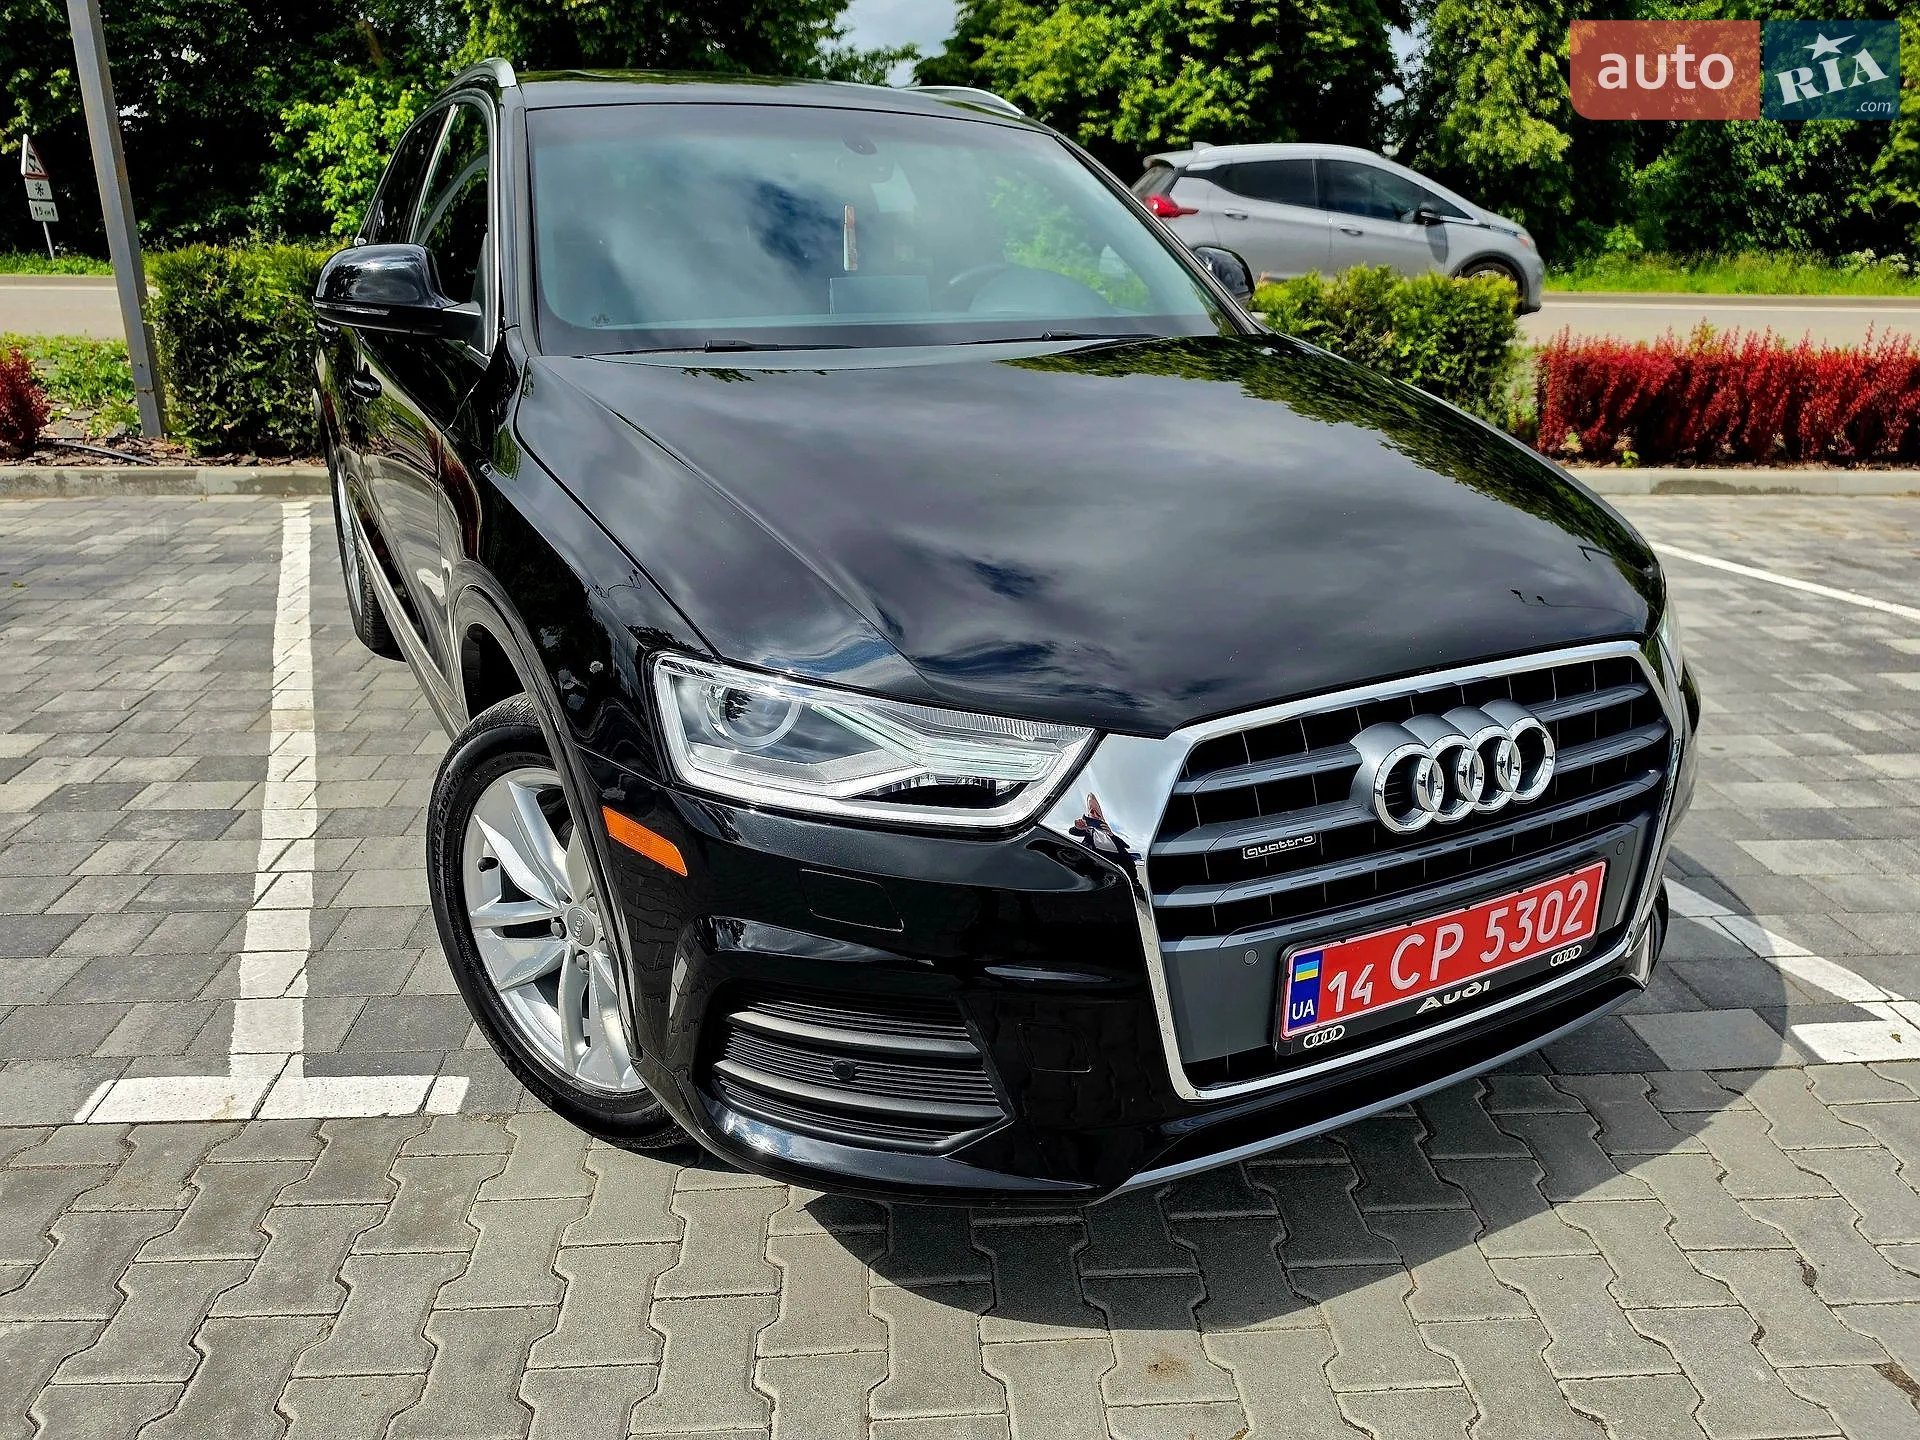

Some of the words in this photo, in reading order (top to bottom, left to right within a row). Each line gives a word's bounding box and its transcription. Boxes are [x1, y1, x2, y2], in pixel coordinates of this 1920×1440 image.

[1246, 834, 1314, 857] quattro
[1327, 963, 1375, 1013] 14
[1389, 922, 1465, 991] CP
[1480, 880, 1589, 963] 5302
[1291, 998, 1316, 1021] UA
[1415, 980, 1491, 1015] Audi
